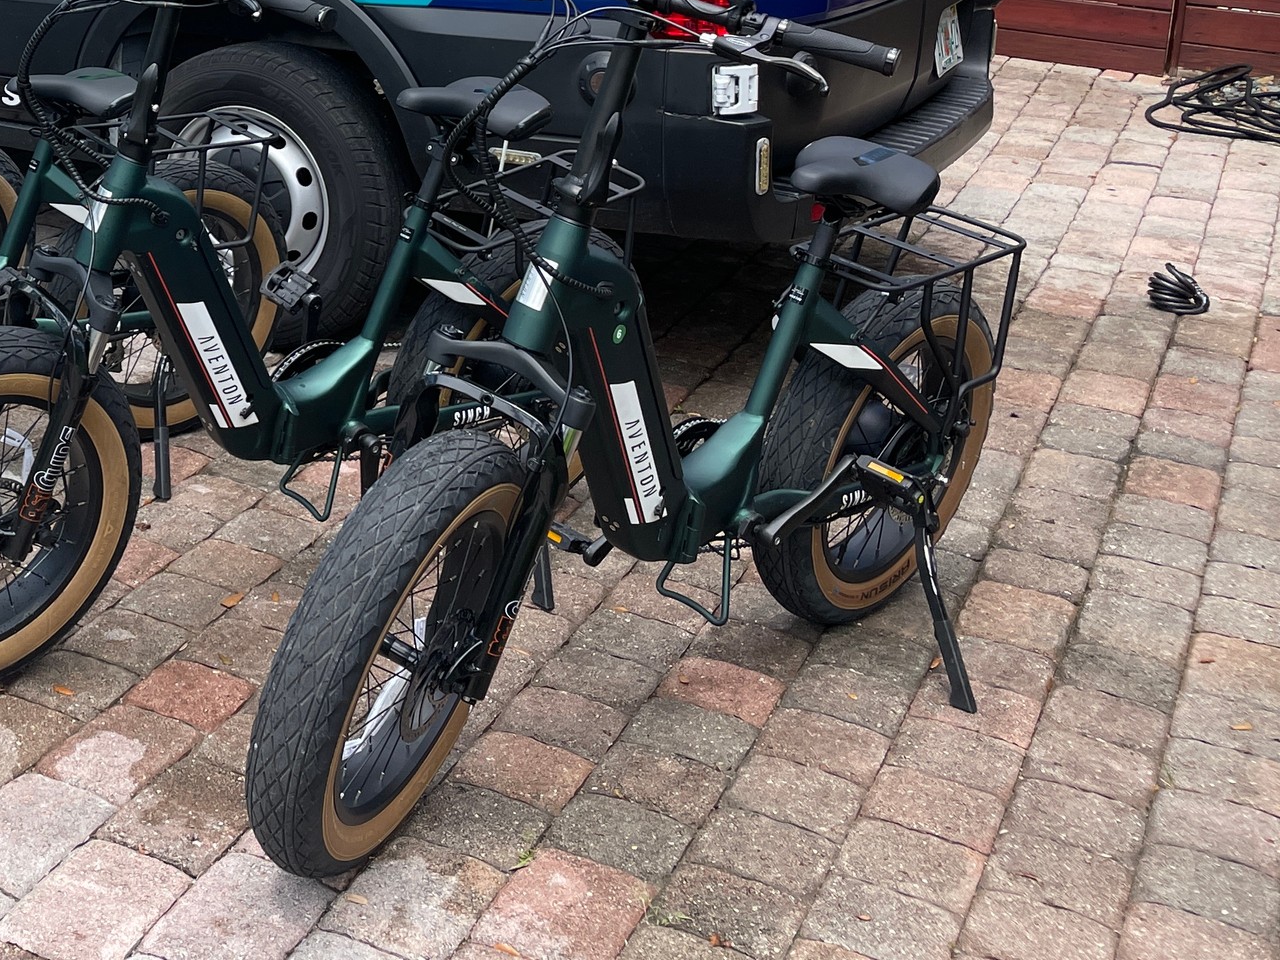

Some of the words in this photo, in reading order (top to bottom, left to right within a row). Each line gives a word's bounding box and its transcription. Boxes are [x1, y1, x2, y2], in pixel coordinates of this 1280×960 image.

[198, 335, 243, 405] AVENTON
[453, 405, 490, 427] SINCH
[625, 419, 657, 499] AVENTON
[860, 559, 911, 601] ARISUN
